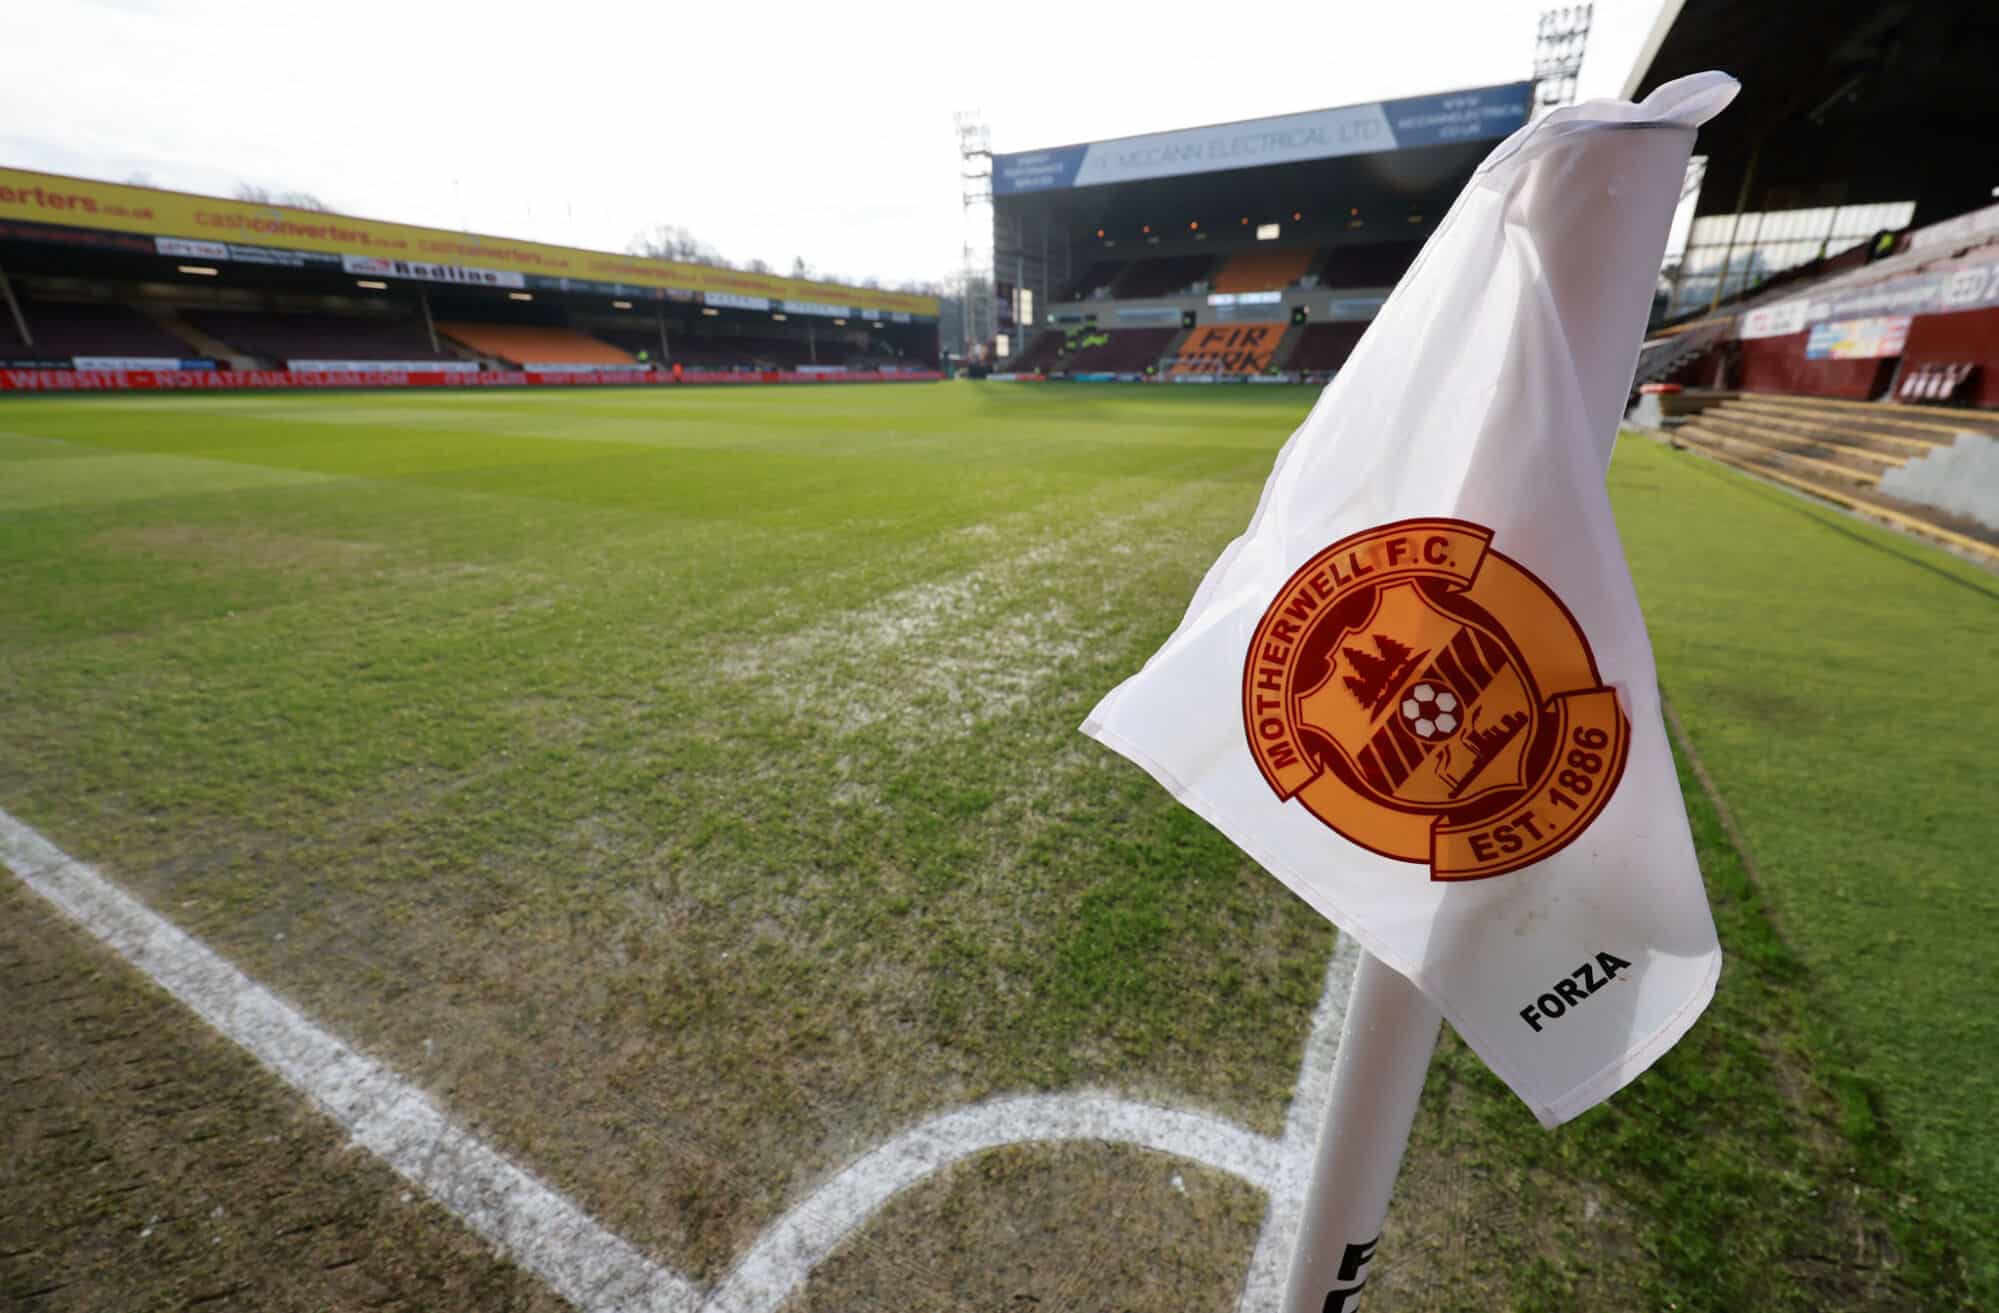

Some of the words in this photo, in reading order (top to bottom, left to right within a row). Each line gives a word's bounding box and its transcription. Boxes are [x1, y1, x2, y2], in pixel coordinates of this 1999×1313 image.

[1207, 124, 1330, 160] ELECTRICAL
[1336, 116, 1383, 143] LTD
[394, 259, 497, 282] Redline
[1200, 326, 1270, 348] FIR
[9, 370, 127, 389] WEBSITE
[1257, 551, 1375, 771] MOTHERWELL
[1385, 536, 1457, 569] F.C.
[1467, 810, 1557, 863] EST.
[1549, 725, 1609, 812] 1886
[1519, 951, 1633, 1033] FORZA
